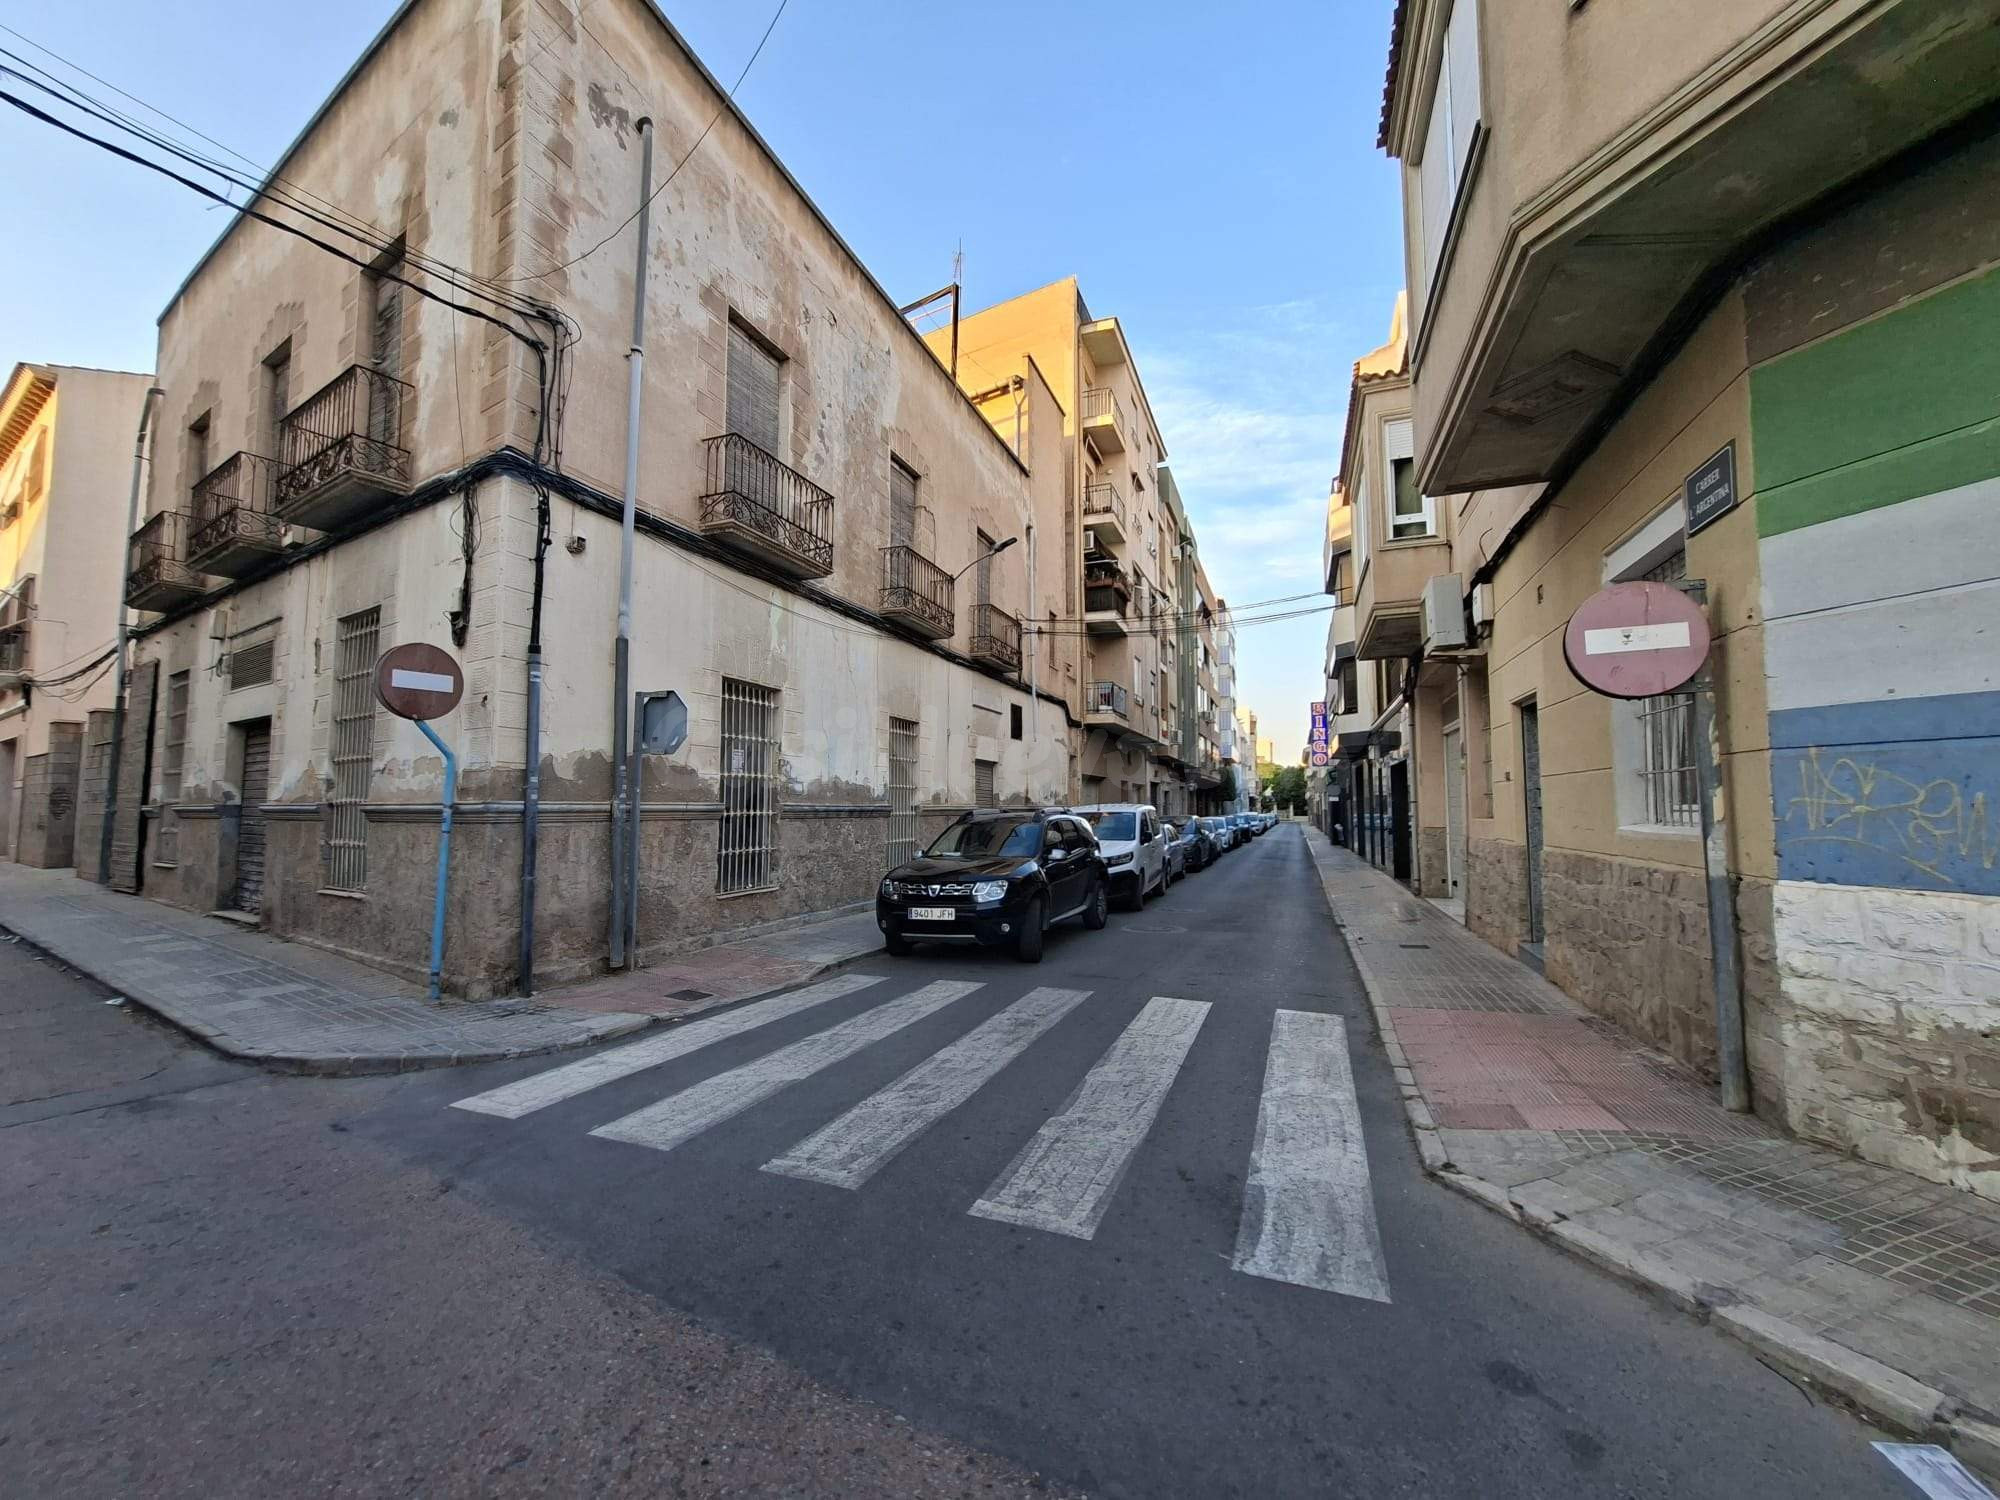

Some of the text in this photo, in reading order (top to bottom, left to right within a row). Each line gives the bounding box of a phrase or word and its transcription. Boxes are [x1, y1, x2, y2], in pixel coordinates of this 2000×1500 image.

[1696, 468, 1720, 494] CARRER
[1312, 703, 1327, 765] BINGO
[914, 909, 953, 919] 9401 JFH
